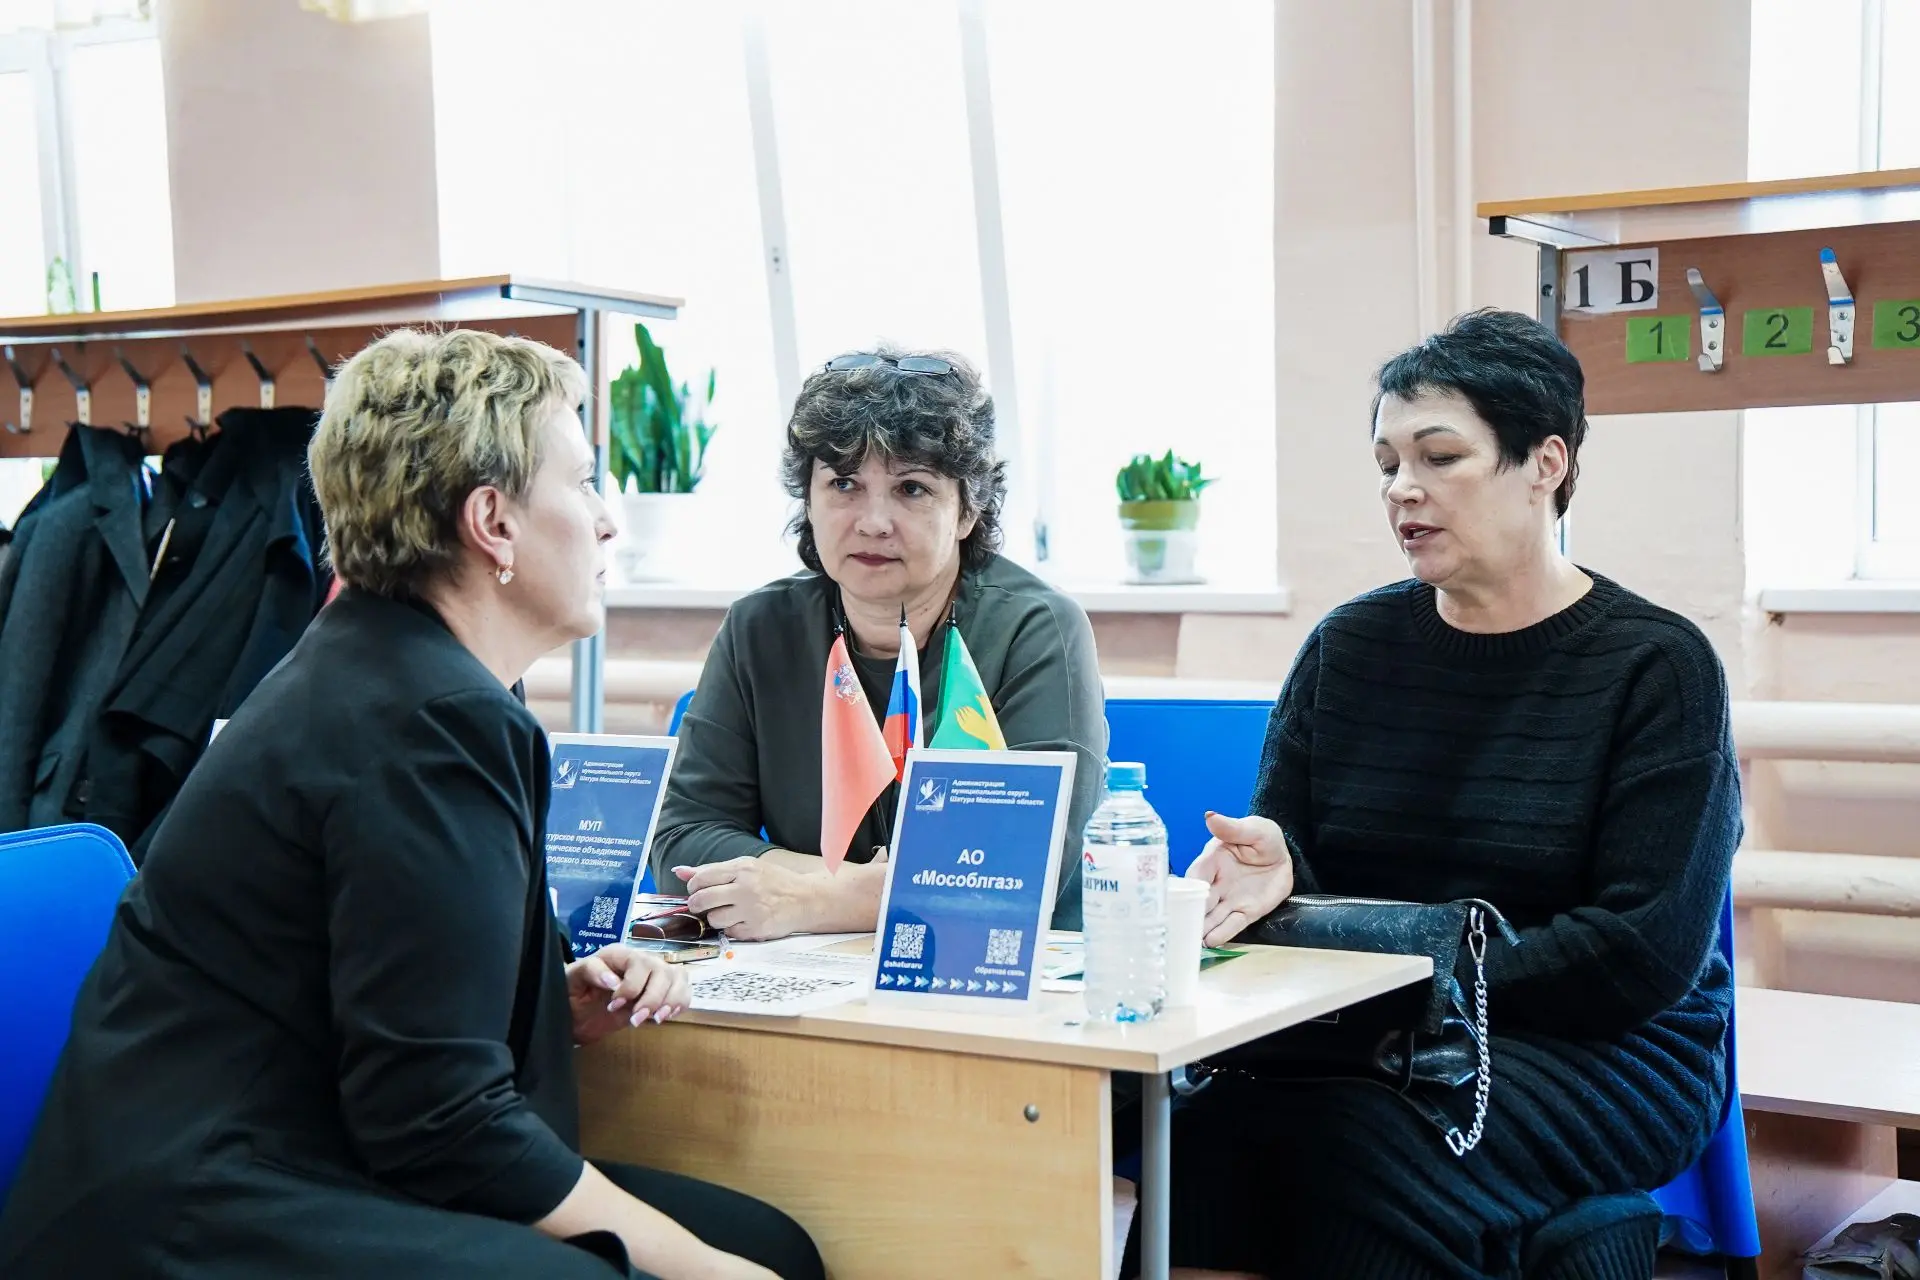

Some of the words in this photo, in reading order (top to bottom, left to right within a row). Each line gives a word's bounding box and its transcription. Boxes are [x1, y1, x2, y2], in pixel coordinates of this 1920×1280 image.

[1573, 264, 1594, 308] 1
[1616, 259, 1655, 305] Б
[1896, 306, 1920, 342] 3
[1765, 314, 1790, 348] 2
[1649, 320, 1663, 355] 1
[579, 775, 599, 783] Шатура
[599, 776, 630, 784] Московской
[624, 770, 641, 778] округа
[952, 779, 1006, 788] Администрация
[951, 788, 1007, 797] муниципального
[1007, 790, 1030, 798] округа
[949, 795, 975, 805] Шатура
[975, 796, 1016, 805] Московской
[1016, 798, 1045, 806] области
[579, 820, 602, 831] МУП
[545, 833, 575, 843] турское
[575, 835, 643, 847] производственно-
[581, 846, 632, 857] объединение
[957, 848, 985, 866] АО
[912, 869, 1024, 891] «Мособлгаз»
[974, 966, 1006, 976] Обратная
[1006, 969, 1026, 977] связь
